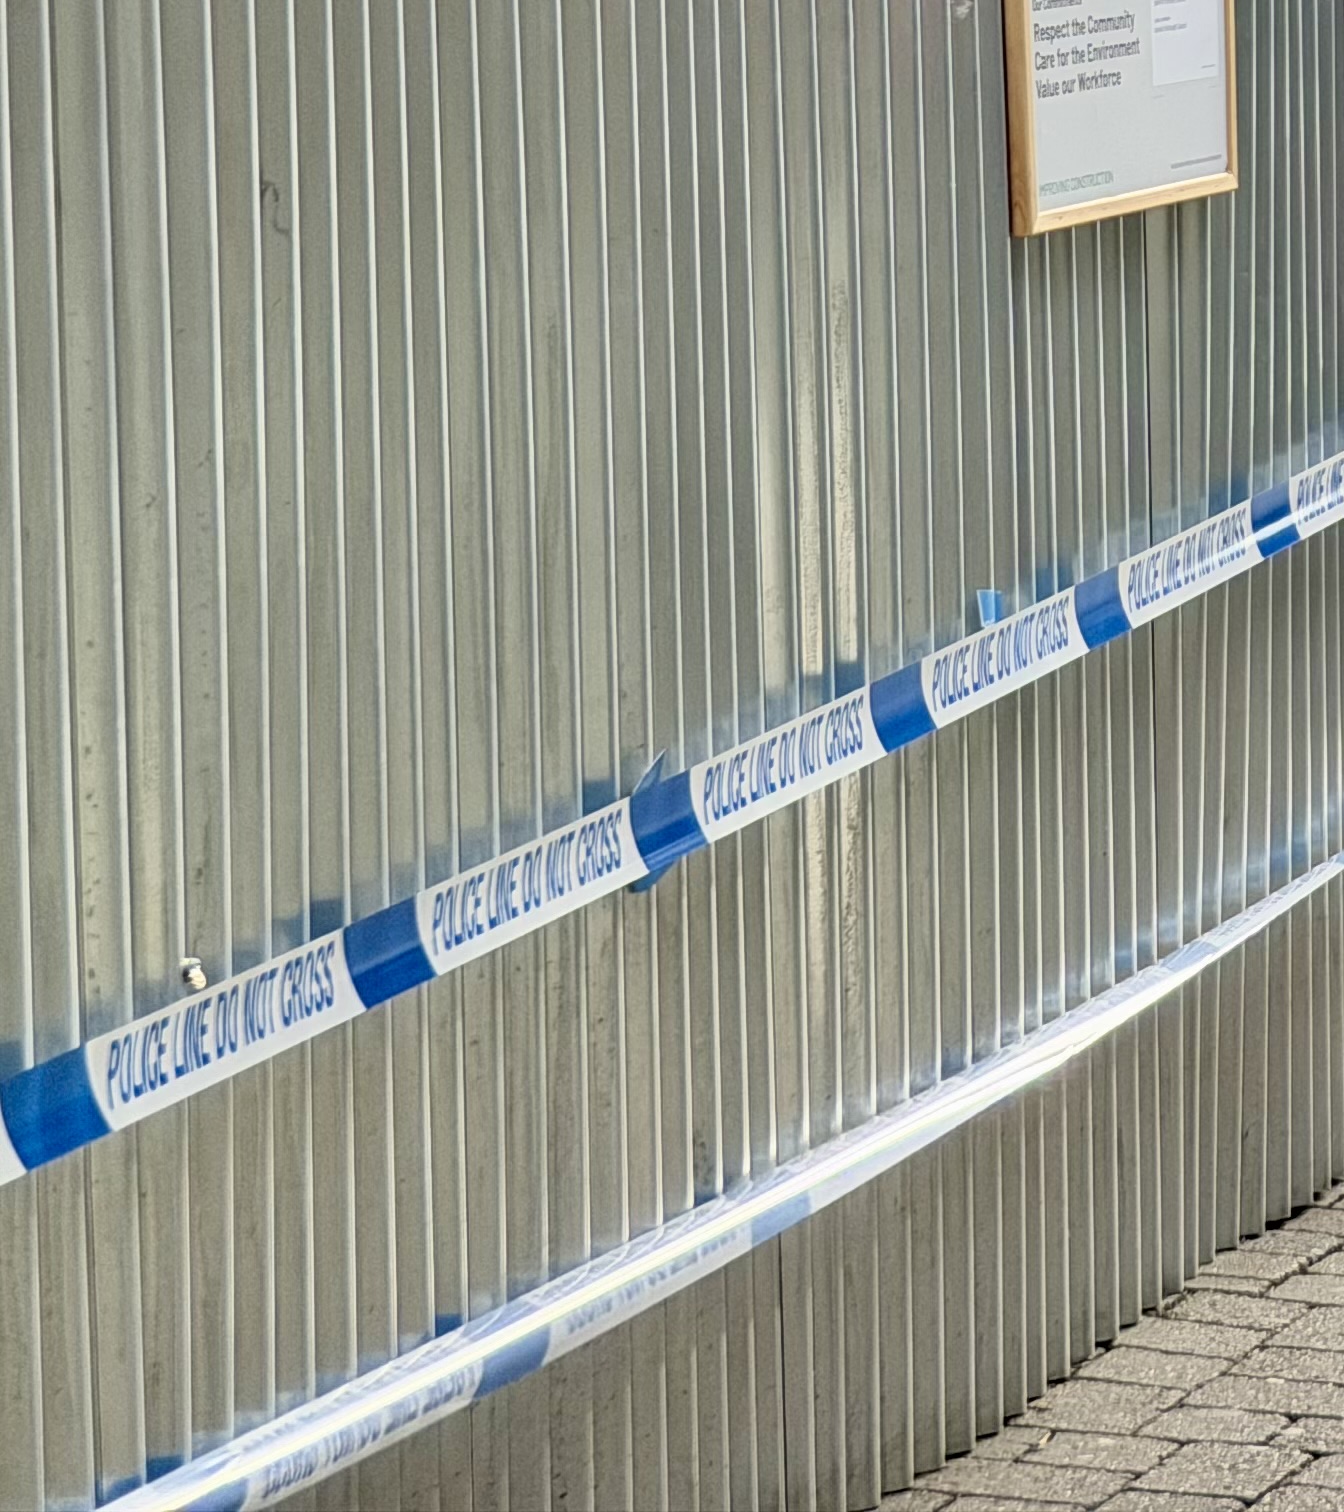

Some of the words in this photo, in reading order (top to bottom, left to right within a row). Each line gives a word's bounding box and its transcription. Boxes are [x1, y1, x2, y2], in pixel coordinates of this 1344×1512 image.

[1033, 20, 1071, 45] Respect
[1071, 18, 1086, 37] the
[1087, 9, 1135, 34] Community
[1035, 51, 1056, 71] Care
[1057, 48, 1070, 67] for
[1071, 46, 1086, 65] the
[1087, 38, 1141, 63] Environment
[1035, 78, 1060, 100] Value
[1062, 79, 1076, 95] our
[1077, 69, 1122, 92] Workforce
[932, 644, 971, 713] POLICE
[971, 631, 996, 693] LINE
[996, 622, 1012, 681] DO
[1014, 611, 1037, 673] NOT
[1036, 595, 1069, 660] CROSS
[703, 749, 749, 826] POLICE
[750, 736, 778, 803] LINE
[779, 726, 797, 789] DO
[799, 713, 825, 779] NOT
[825, 693, 864, 766] CROSS
[433, 872, 486, 956] POLICE
[488, 855, 520, 930] LINE
[522, 844, 543, 913] DO
[546, 829, 576, 902] NOT
[577, 807, 623, 887] CROSS
[107, 1015, 171, 1110] POLICE
[174, 996, 213, 1079] LINE
[216, 984, 239, 1059] DO
[244, 966, 279, 1046] NOT
[281, 940, 335, 1028] CROSS
